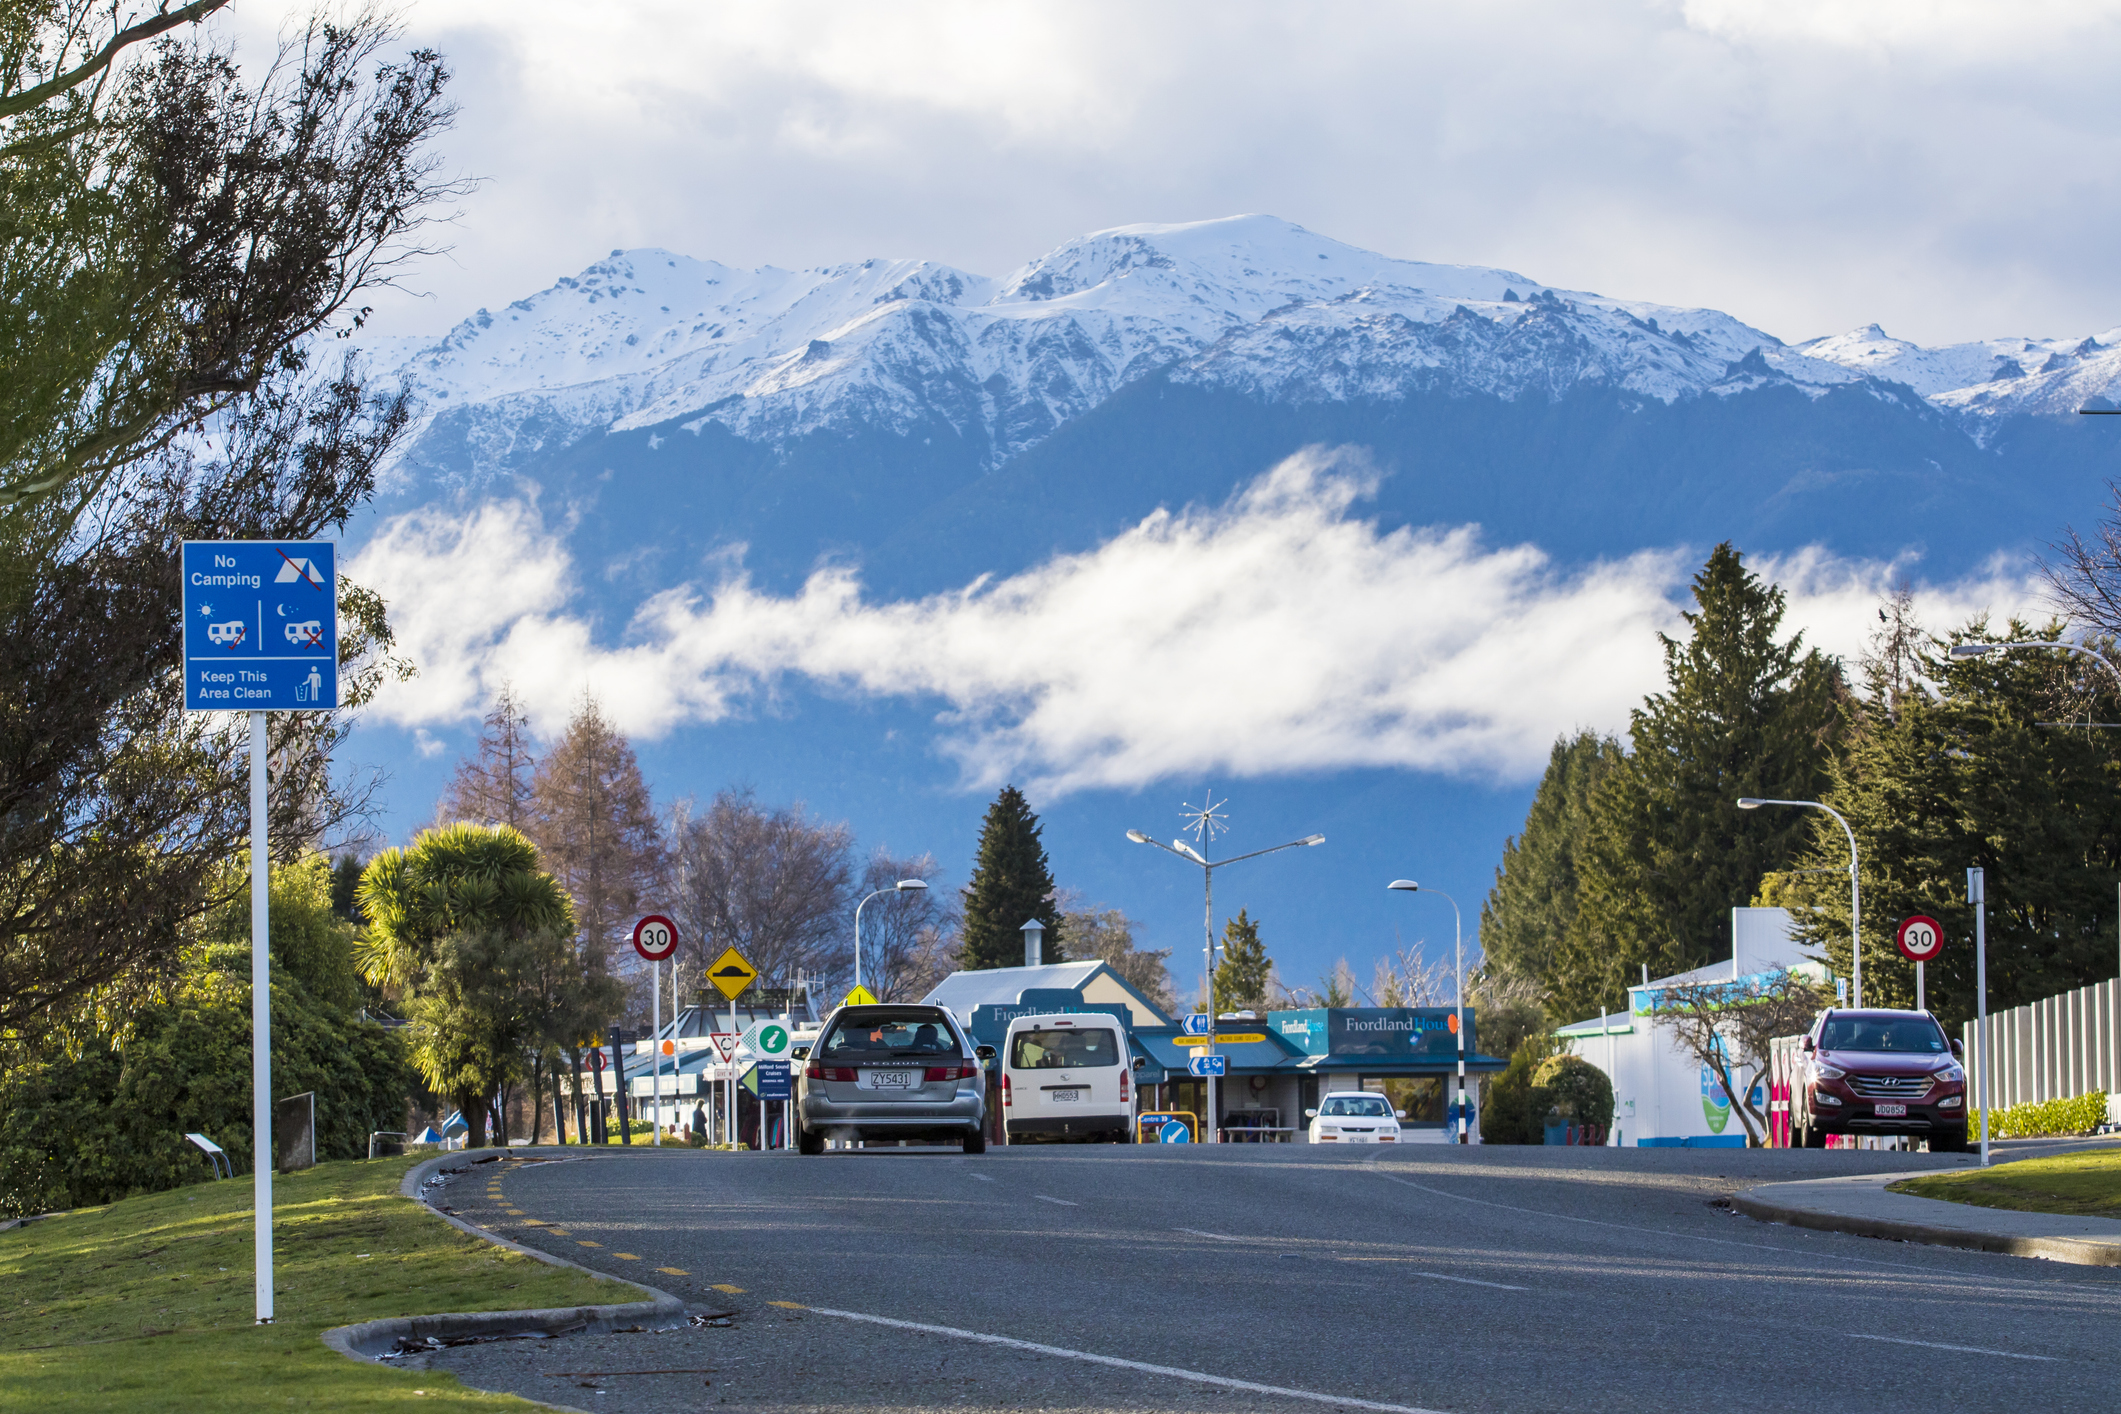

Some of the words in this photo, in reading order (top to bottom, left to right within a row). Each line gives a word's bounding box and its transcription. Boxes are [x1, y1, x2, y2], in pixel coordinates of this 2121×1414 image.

[215, 555, 236, 568] No
[191, 572, 261, 589] Camping
[201, 671, 235, 684] Keep
[239, 671, 268, 682] This
[199, 687, 230, 698] Area
[234, 687, 272, 698] Clean
[644, 929, 668, 946] 30
[1908, 930, 1932, 947] 30
[872, 1073, 909, 1084] ZY5431
